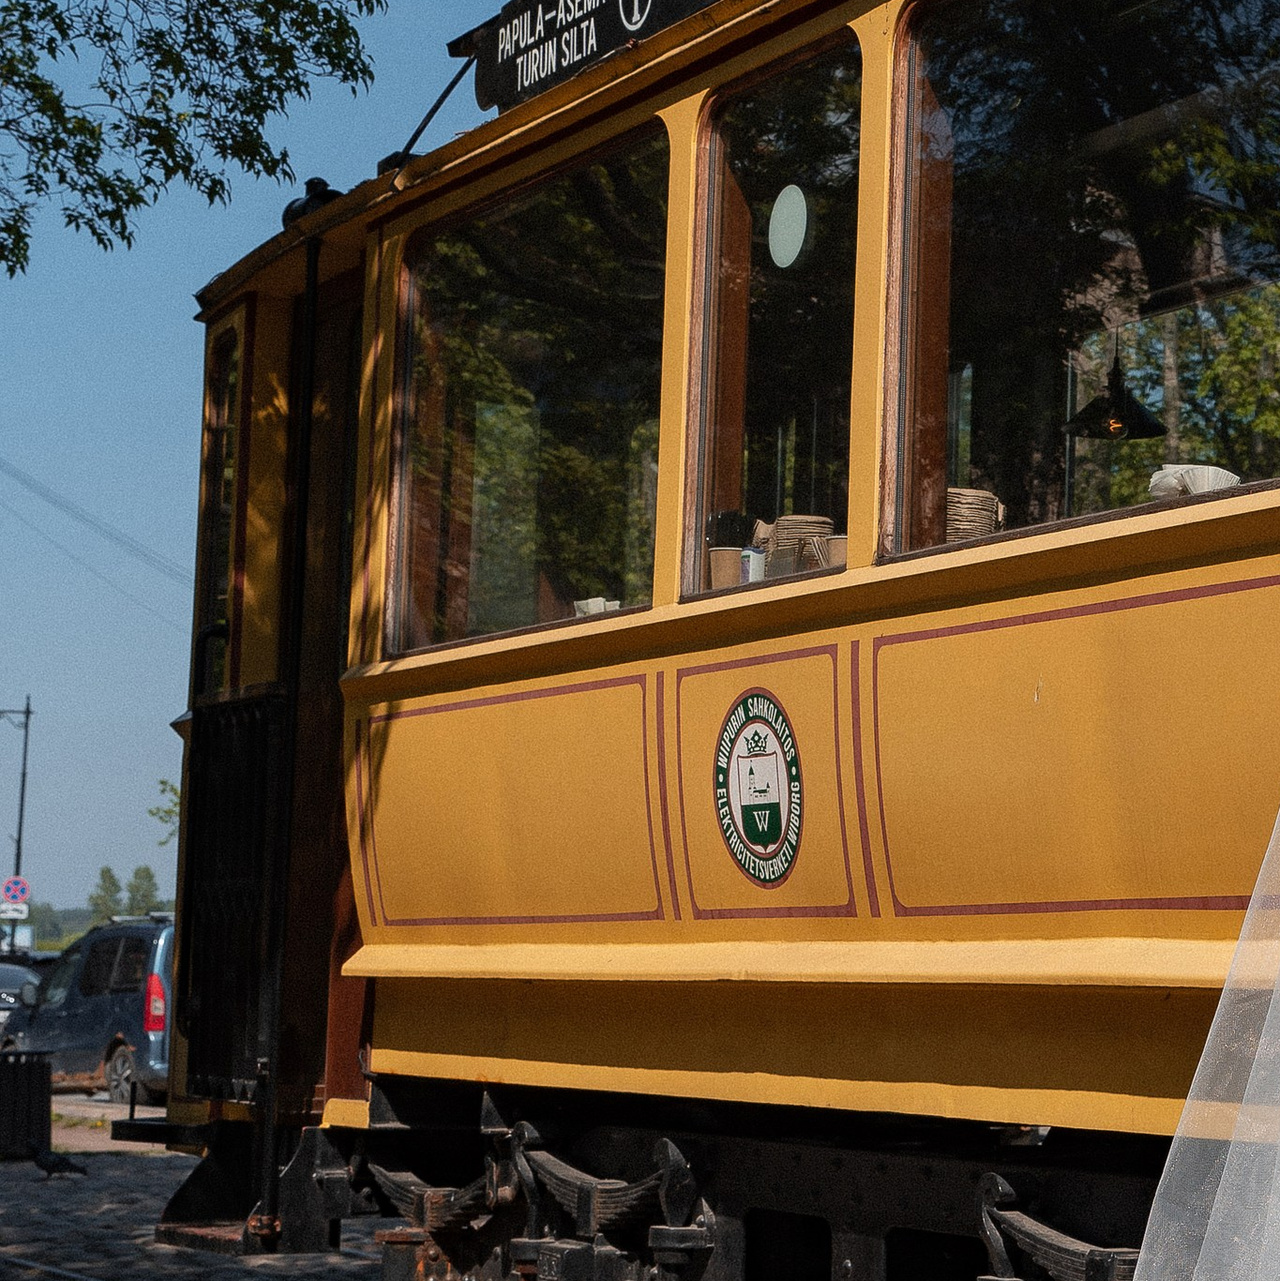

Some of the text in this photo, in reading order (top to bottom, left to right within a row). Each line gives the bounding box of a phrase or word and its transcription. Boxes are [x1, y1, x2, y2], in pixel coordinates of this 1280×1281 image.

[516, 17, 598, 92] TURUN SILTA
[717, 704, 746, 769] WIIPURIN
[752, 810, 770, 832] W
[786, 781, 801, 846] WIBORG
